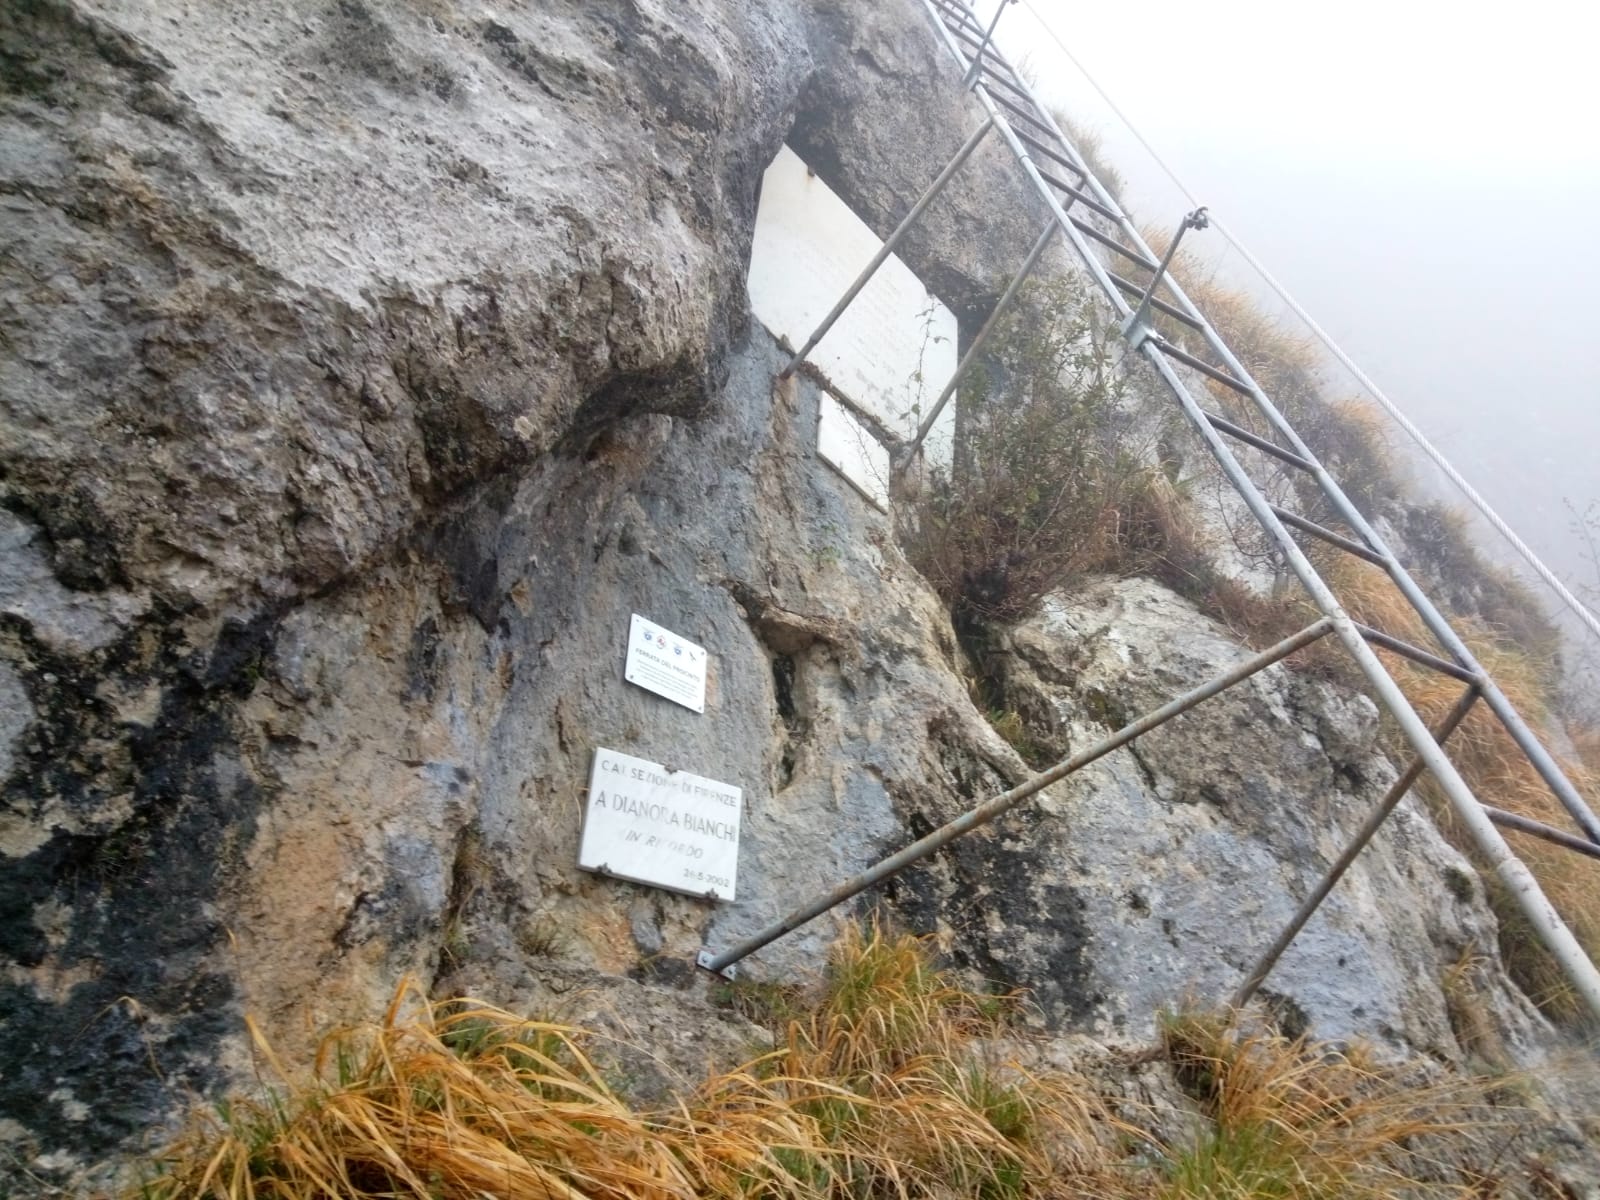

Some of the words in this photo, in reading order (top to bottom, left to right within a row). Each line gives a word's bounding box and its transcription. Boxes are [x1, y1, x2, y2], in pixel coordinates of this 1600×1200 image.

[601, 759, 625, 774] CAI
[595, 790, 607, 808] A
[612, 793, 680, 826] DIANORA
[625, 829, 642, 842] IN
[645, 834, 705, 859] RIORDO
